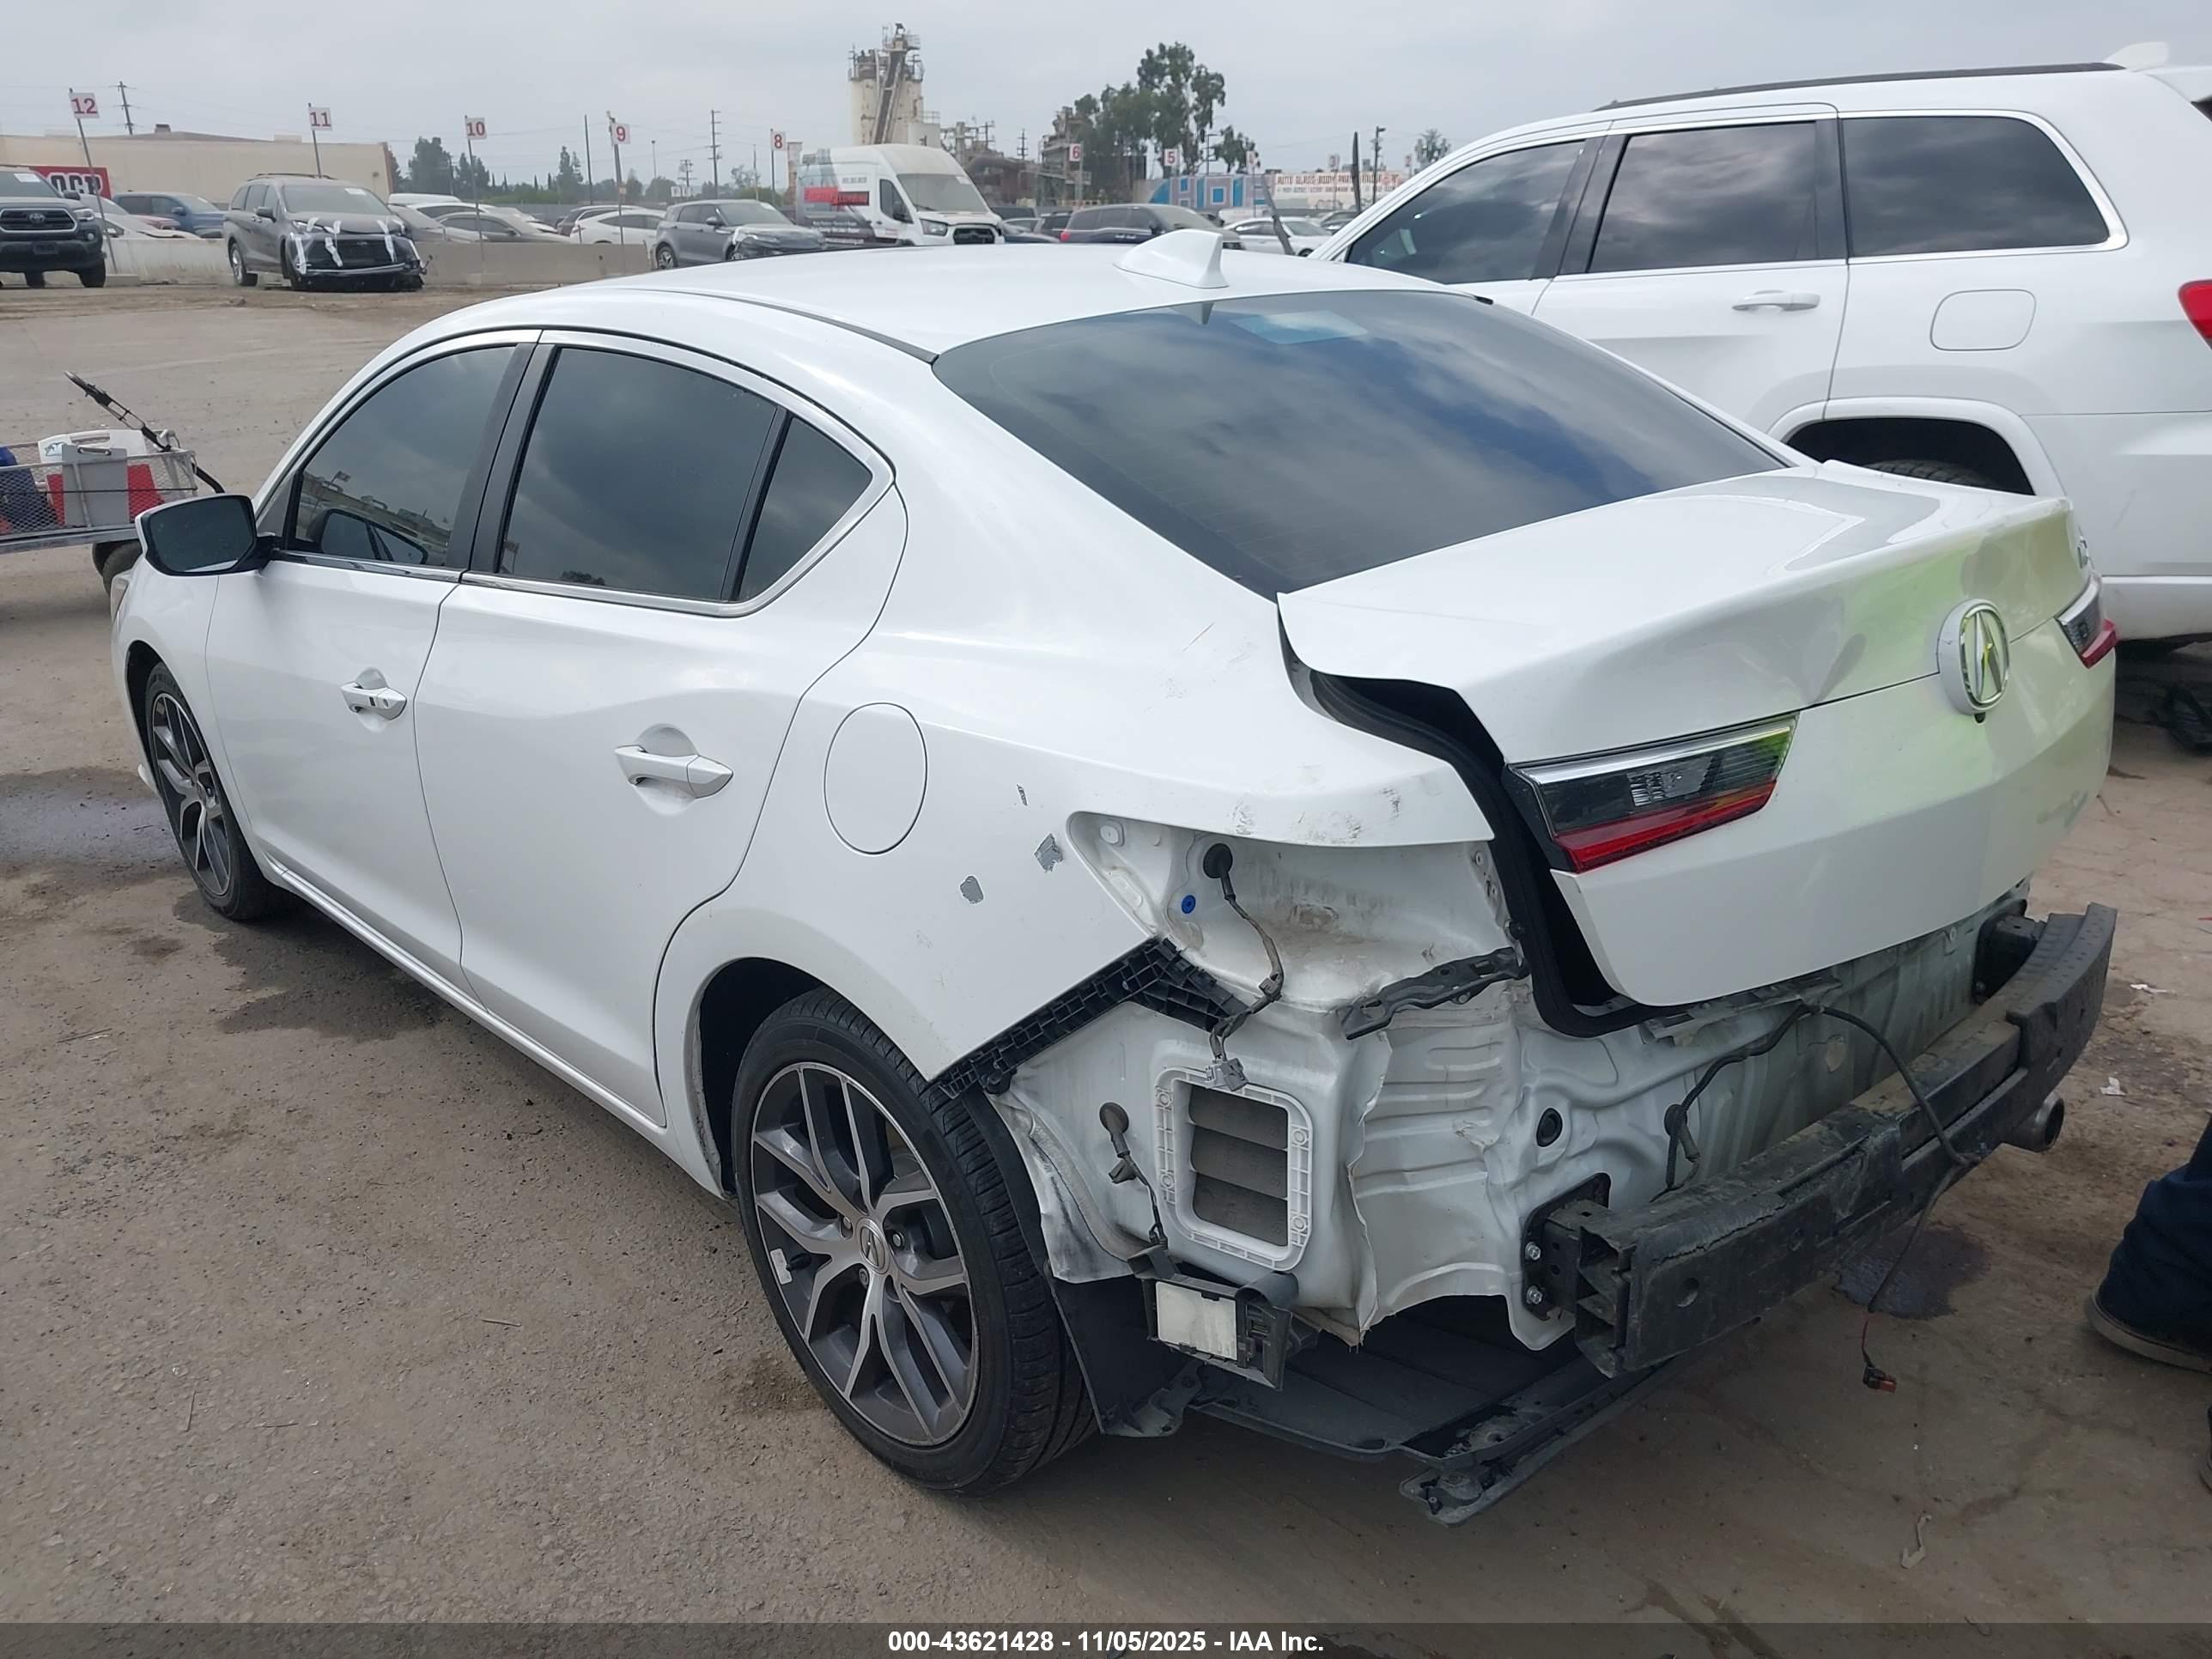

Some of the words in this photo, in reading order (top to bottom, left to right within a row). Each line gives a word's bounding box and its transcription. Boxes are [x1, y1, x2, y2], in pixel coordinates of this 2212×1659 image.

[71, 98, 97, 114] 12
[310, 112, 331, 127] 11
[466, 121, 486, 137] 10
[616, 125, 627, 142] 9
[774, 133, 783, 149] 8
[1073, 145, 1080, 160] 6
[1167, 151, 1176, 164] 5
